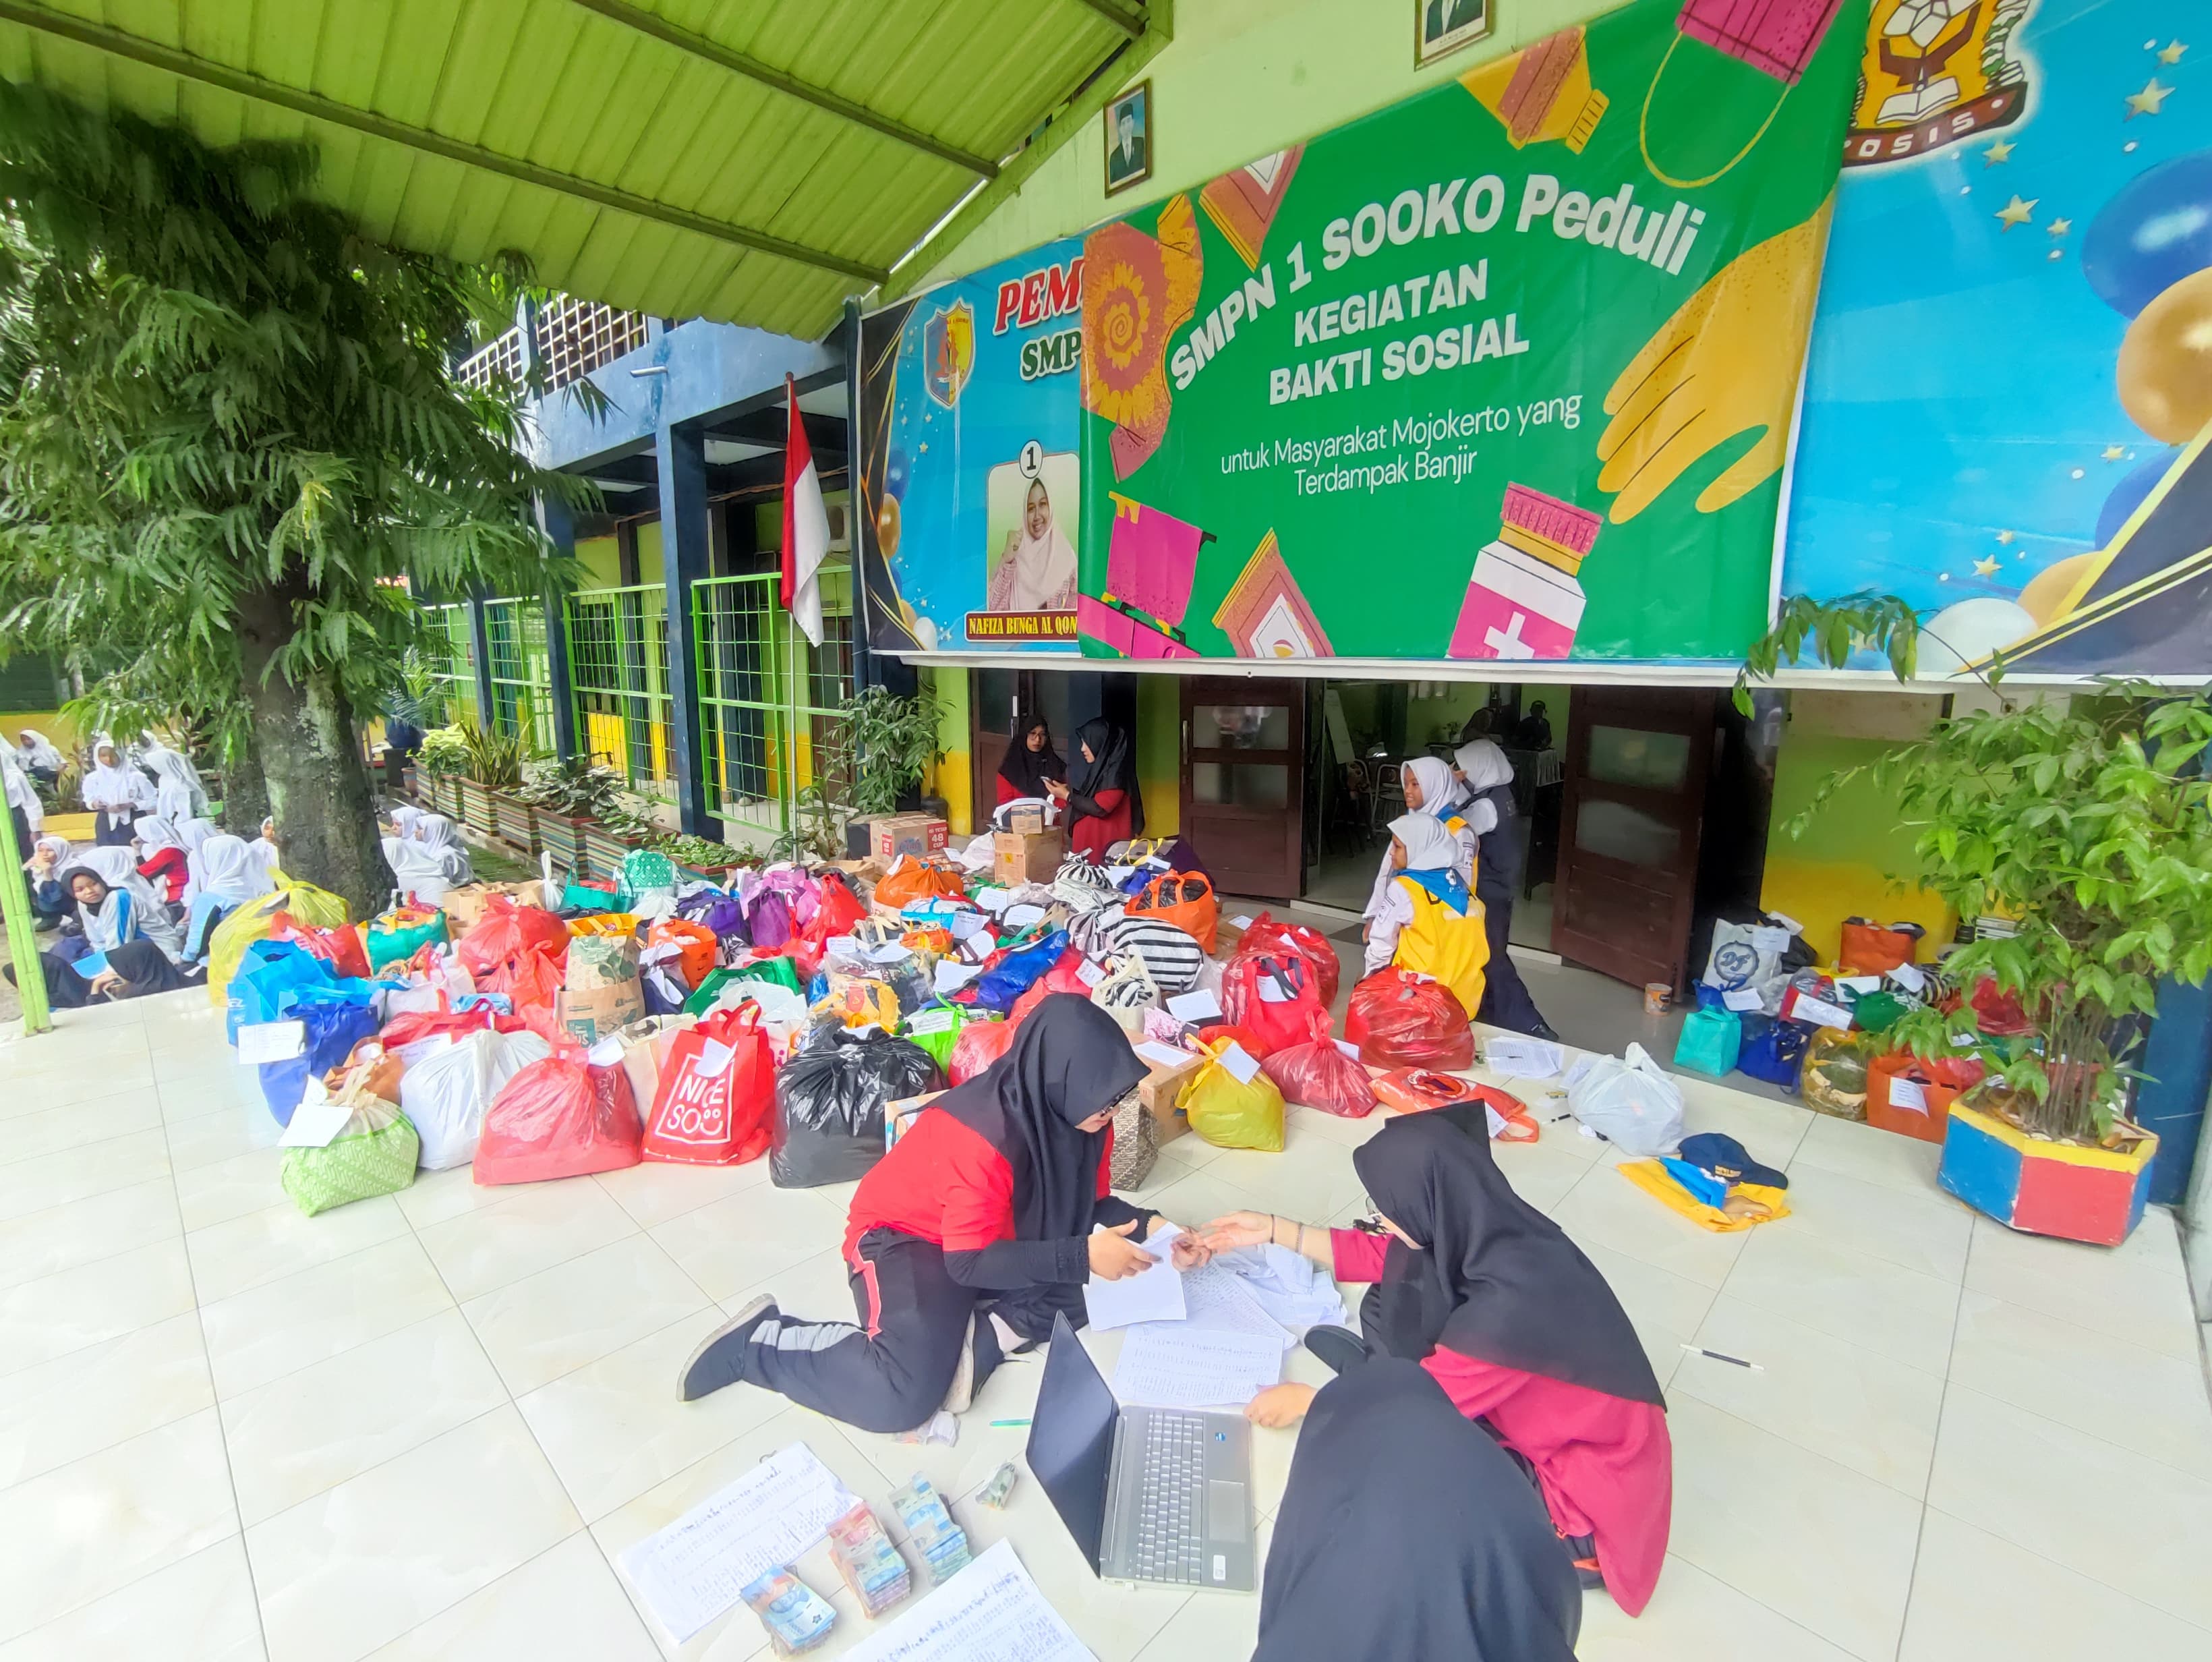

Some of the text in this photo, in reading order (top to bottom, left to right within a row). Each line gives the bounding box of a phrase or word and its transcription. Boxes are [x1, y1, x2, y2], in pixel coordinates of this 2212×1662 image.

[1859, 111, 1975, 157] OSIS
[1171, 174, 1706, 391] SMPN 1 SOOKO Peduli
[1295, 259, 1488, 347] KEGIATAN
[1269, 313, 1530, 405] BAKTI SOSIAL
[1026, 446, 1037, 471] 1
[1222, 395, 1583, 475] untuk Masyarakat Mojokerto yang
[1295, 445, 1478, 495] Terdampak Banjir
[969, 618, 1003, 634] NAFIZA
[1006, 617, 1039, 634] BUNGA
[1041, 617, 1053, 634] AL
[931, 833, 944, 842] 48
[678, 1074, 726, 1108] NICE
